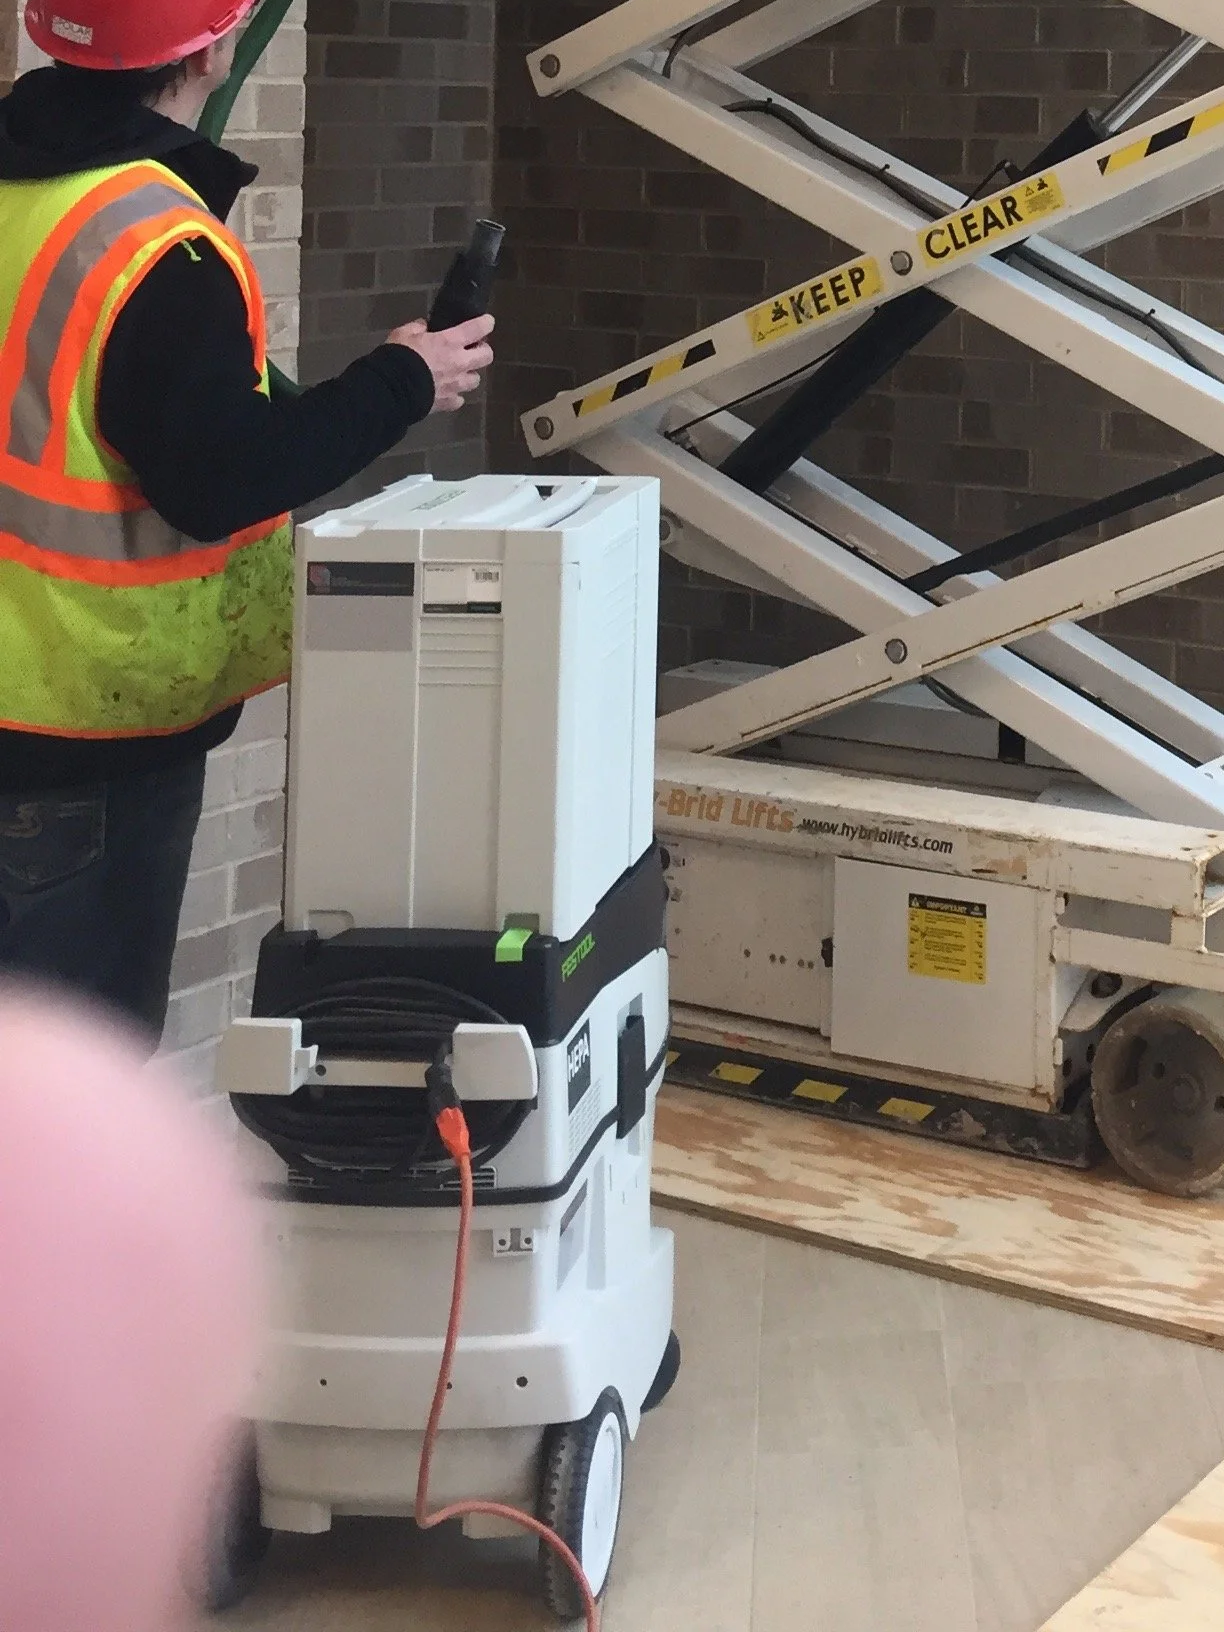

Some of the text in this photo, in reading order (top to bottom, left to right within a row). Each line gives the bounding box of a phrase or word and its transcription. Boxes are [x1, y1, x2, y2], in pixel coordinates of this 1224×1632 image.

[788, 266, 866, 325] KEEP
[925, 195, 1024, 259] CLEAR
[730, 797, 795, 833] Lifts
[567, 1033, 590, 1083] HEPA
